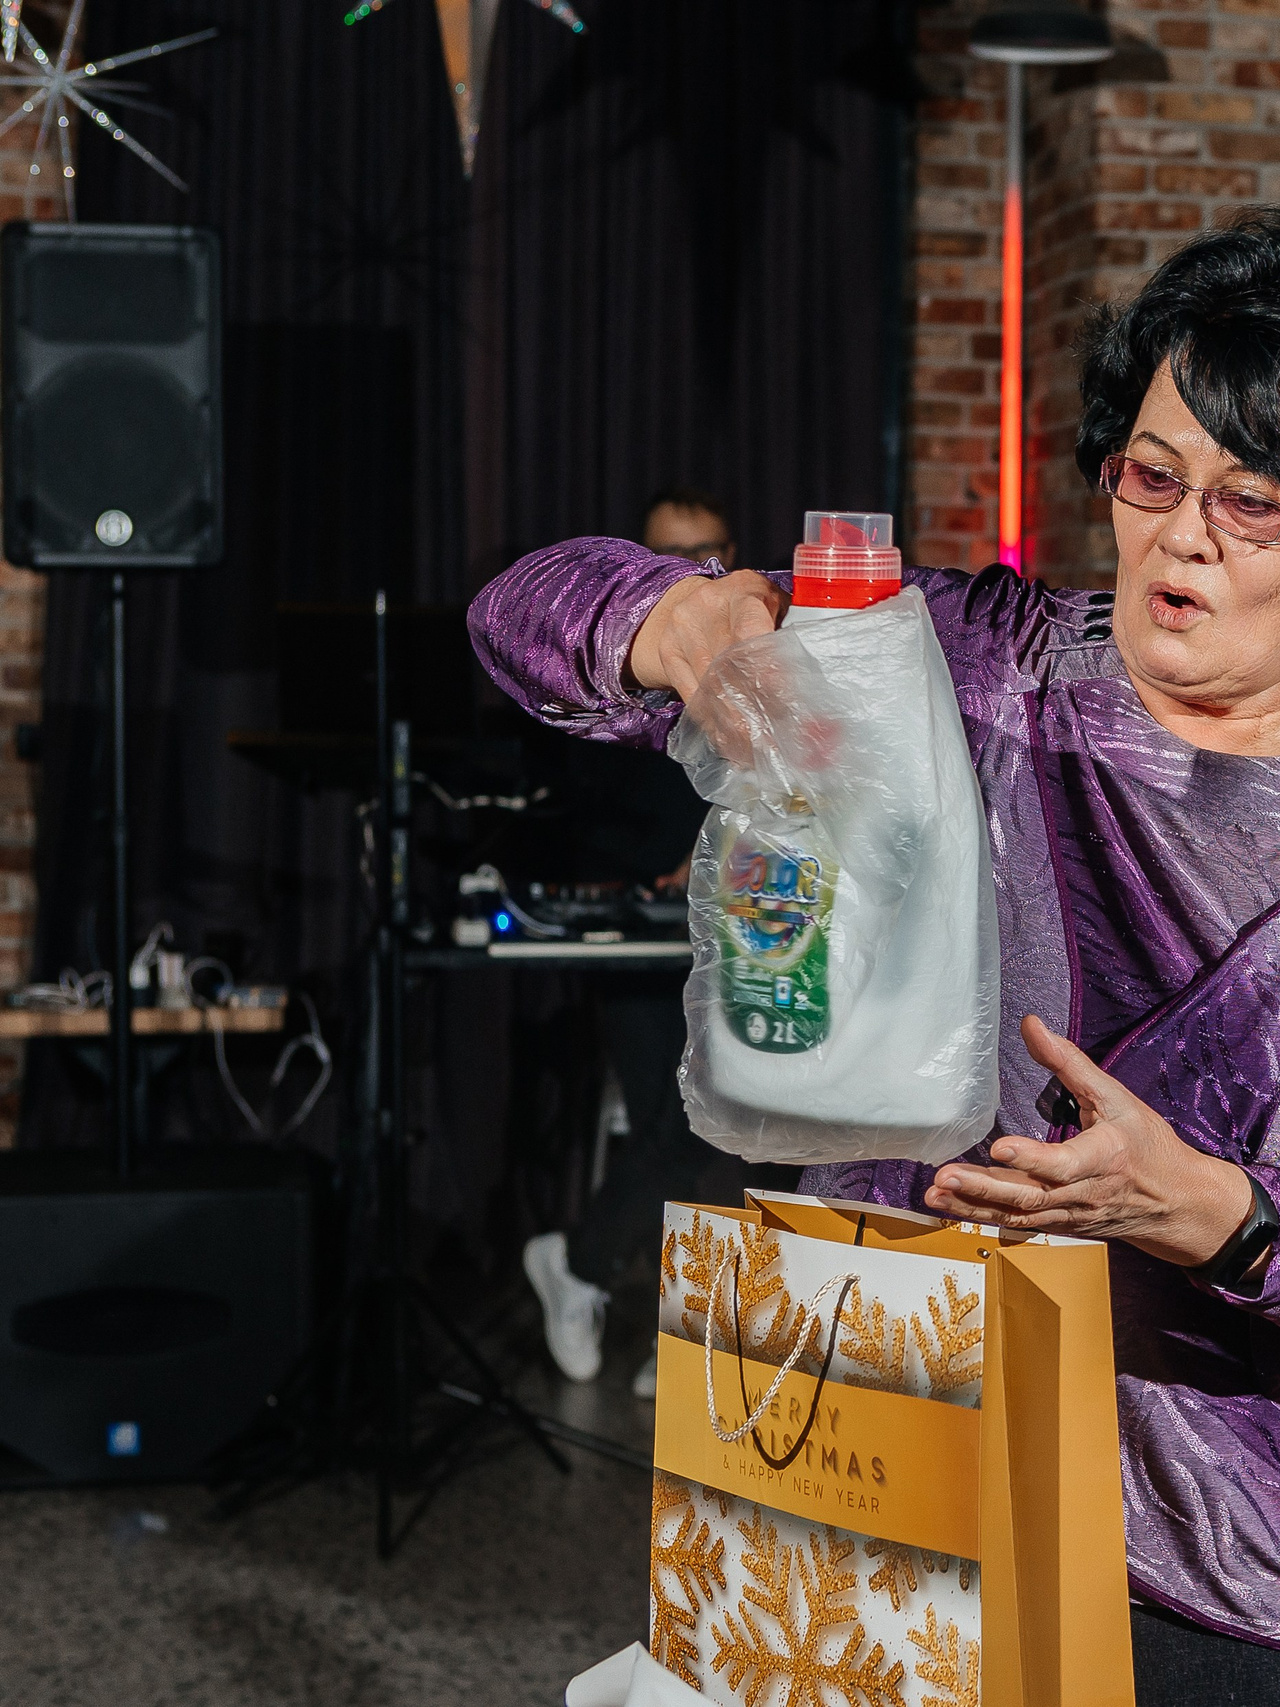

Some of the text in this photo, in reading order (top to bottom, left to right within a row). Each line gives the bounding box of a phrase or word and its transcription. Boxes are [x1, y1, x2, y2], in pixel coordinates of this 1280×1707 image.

[722, 1454, 880, 1514] & HAPPY NEW YEAR
